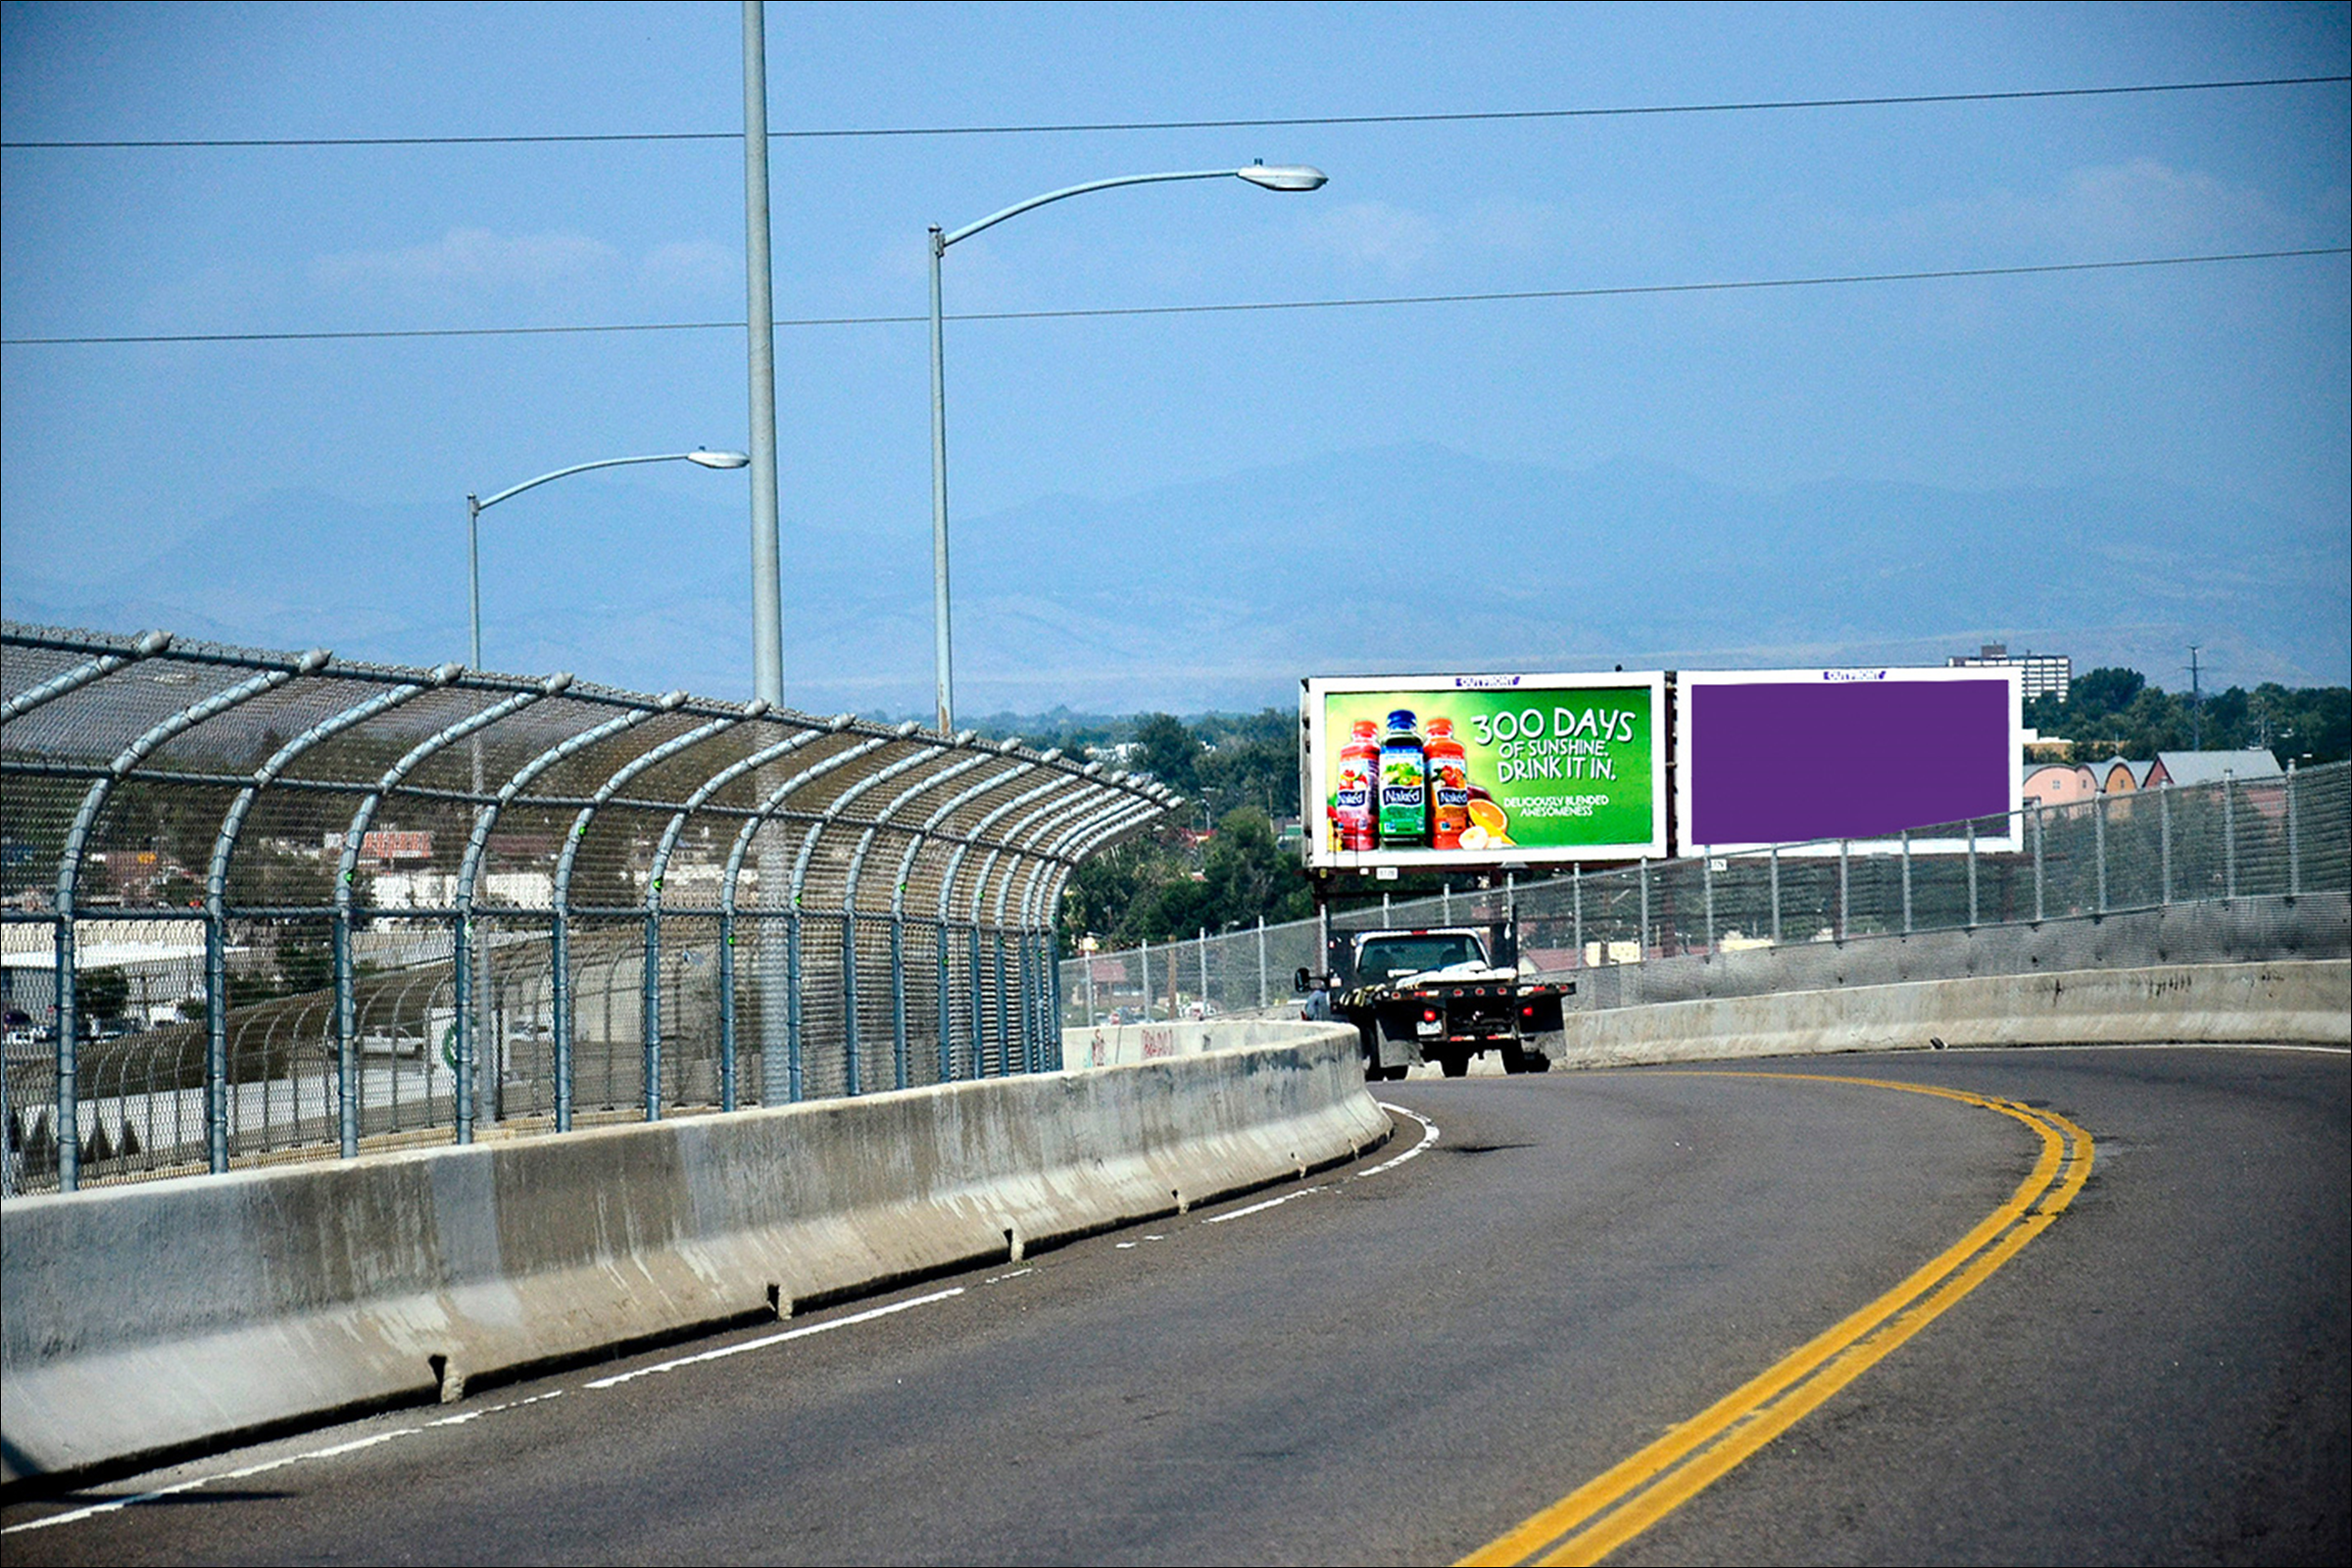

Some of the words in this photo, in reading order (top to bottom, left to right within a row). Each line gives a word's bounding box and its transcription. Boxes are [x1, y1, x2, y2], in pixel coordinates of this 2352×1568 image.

[1471, 709, 1544, 745] 300
[1554, 707, 1636, 742] DAYS
[1498, 741, 1525, 759] OF
[1497, 756, 1562, 783] DRINK
[1567, 758, 1586, 779] IT
[1591, 758, 1617, 781] IN.
[1503, 796, 1565, 808] DELICIOUSLY
[1568, 794, 1609, 806] BLENDED
[1520, 806, 1592, 817] AWESOMENESS
